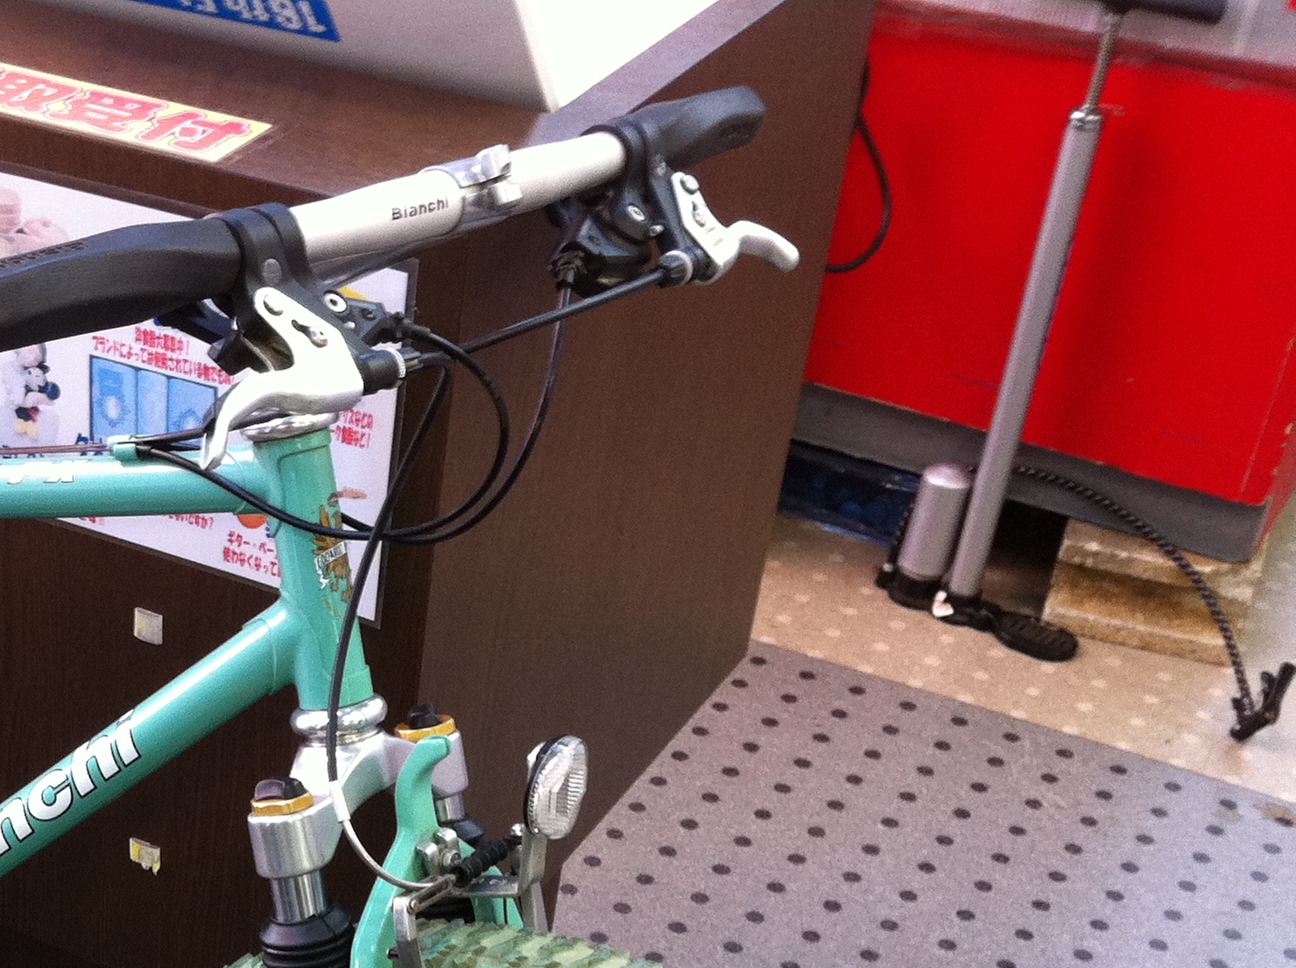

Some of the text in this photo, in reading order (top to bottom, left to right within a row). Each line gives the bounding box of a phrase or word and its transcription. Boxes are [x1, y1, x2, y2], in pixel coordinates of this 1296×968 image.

[391, 196, 449, 220] Bianchi
[227, 530, 281, 560] ギター・ベー
